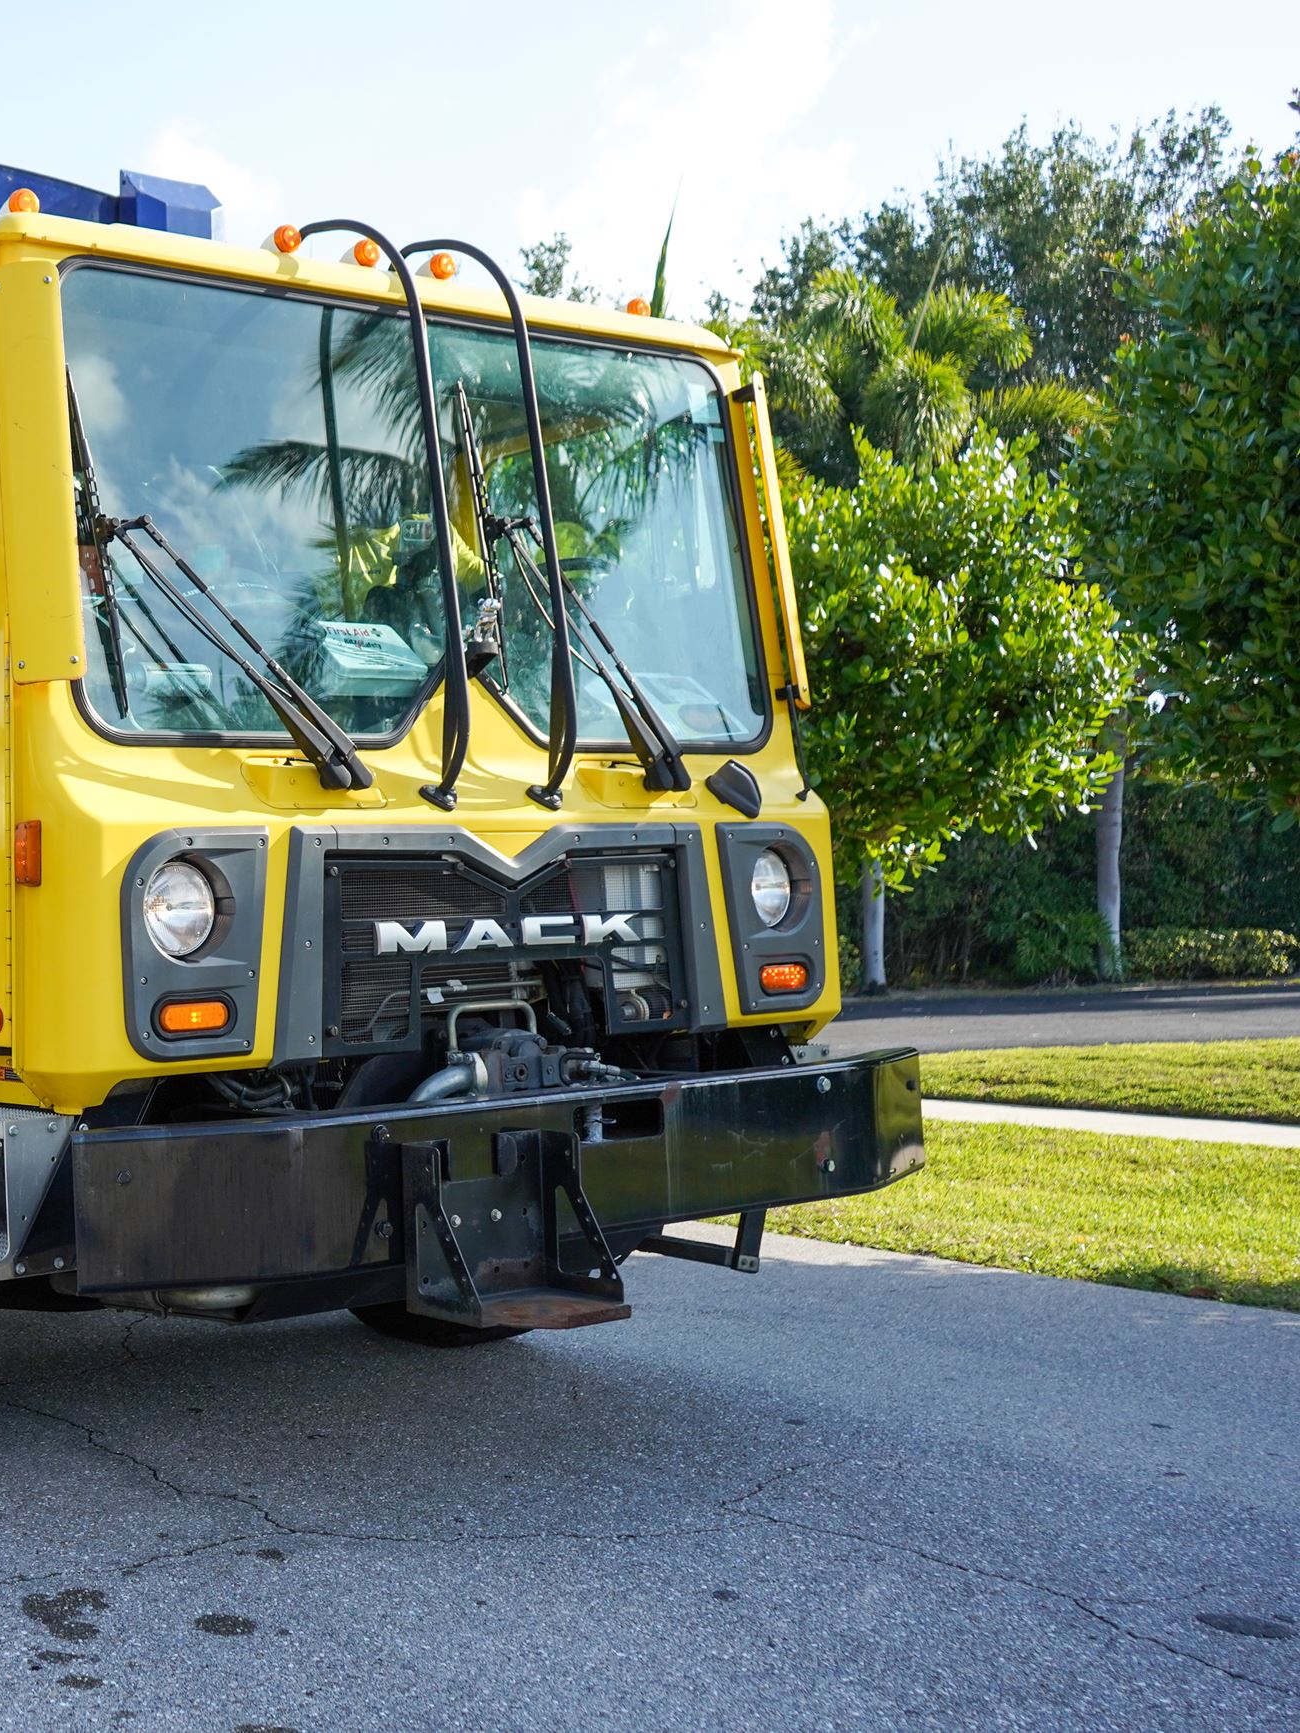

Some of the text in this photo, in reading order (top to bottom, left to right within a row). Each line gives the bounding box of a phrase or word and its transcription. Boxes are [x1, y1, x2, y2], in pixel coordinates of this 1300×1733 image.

[326, 626, 370, 637] First Aid
[373, 912, 641, 955] MACK
